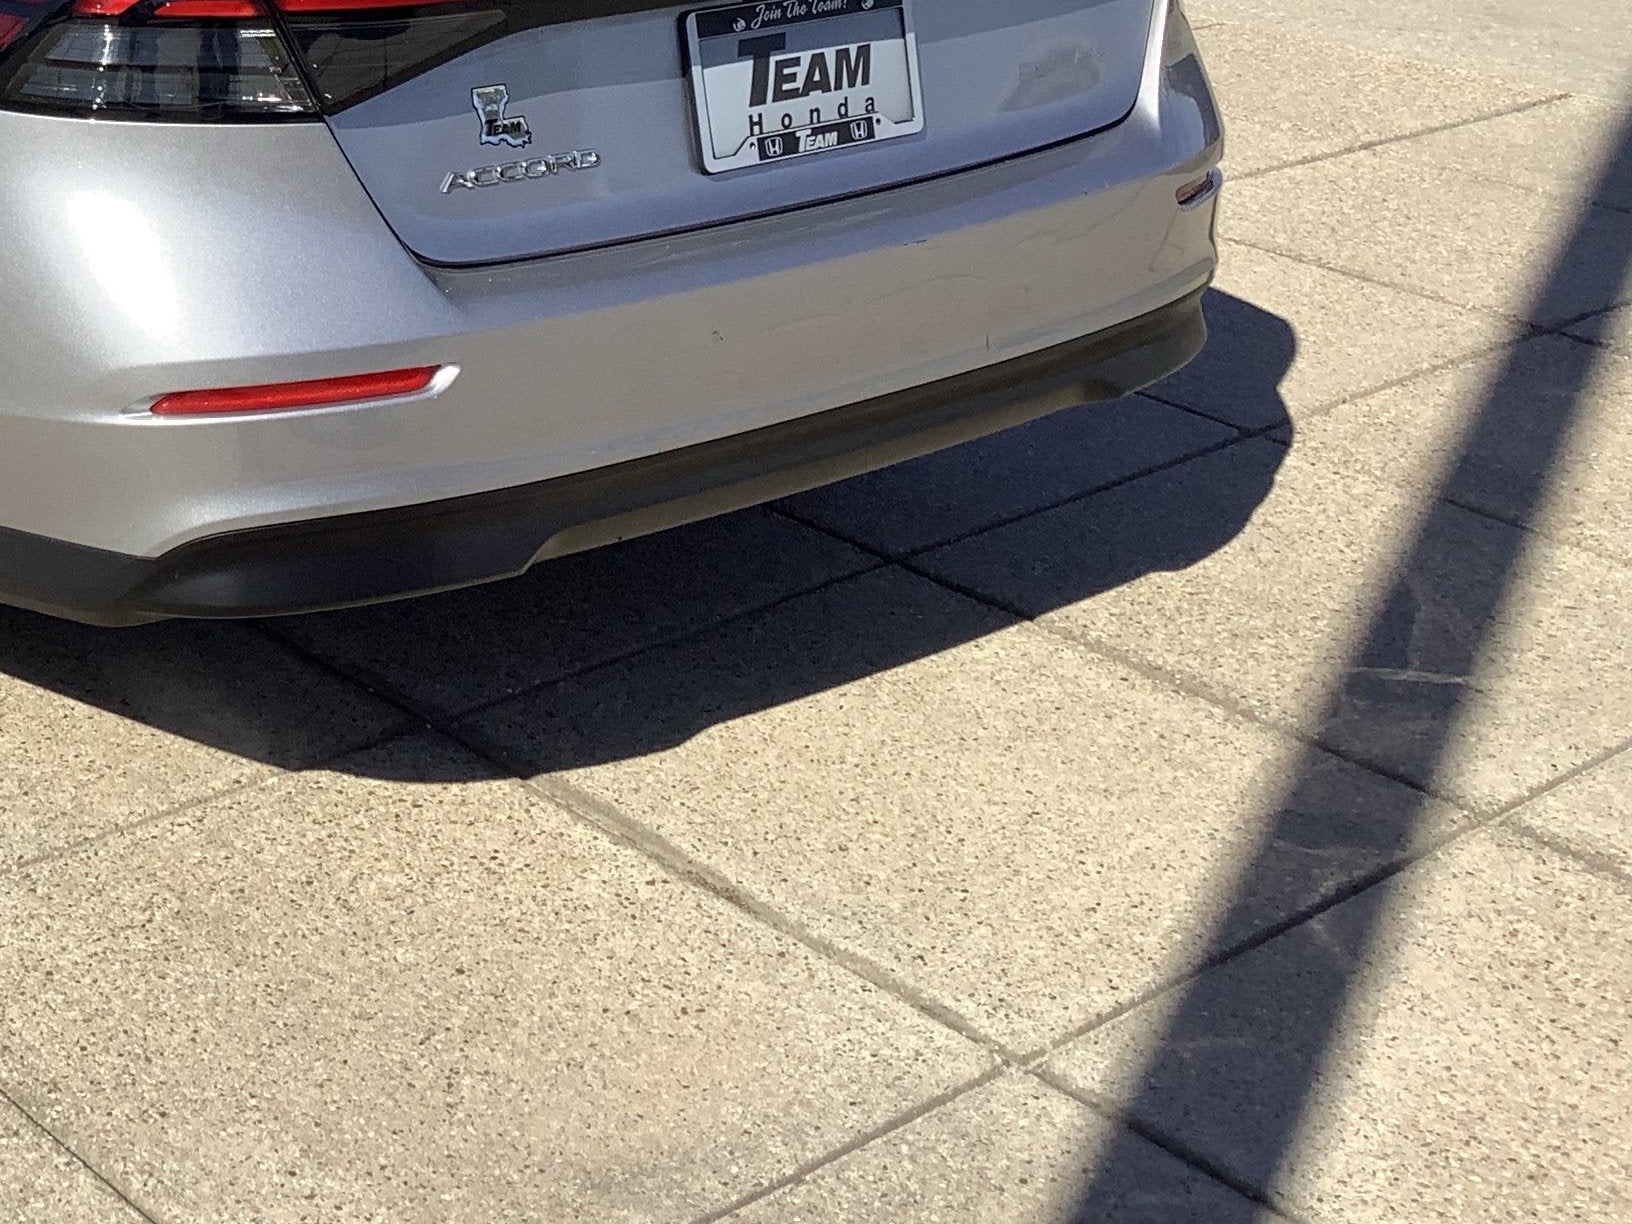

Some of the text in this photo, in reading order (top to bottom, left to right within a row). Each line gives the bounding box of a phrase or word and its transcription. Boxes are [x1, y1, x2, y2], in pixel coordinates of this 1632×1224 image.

[751, 4, 782, 29] Join
[782, 0, 808, 19] The
[737, 32, 871, 108] TEAM
[485, 117, 522, 137] TEAM
[748, 96, 877, 136] Honda
[796, 128, 838, 153] TEAM
[440, 148, 601, 194] ACCORD
